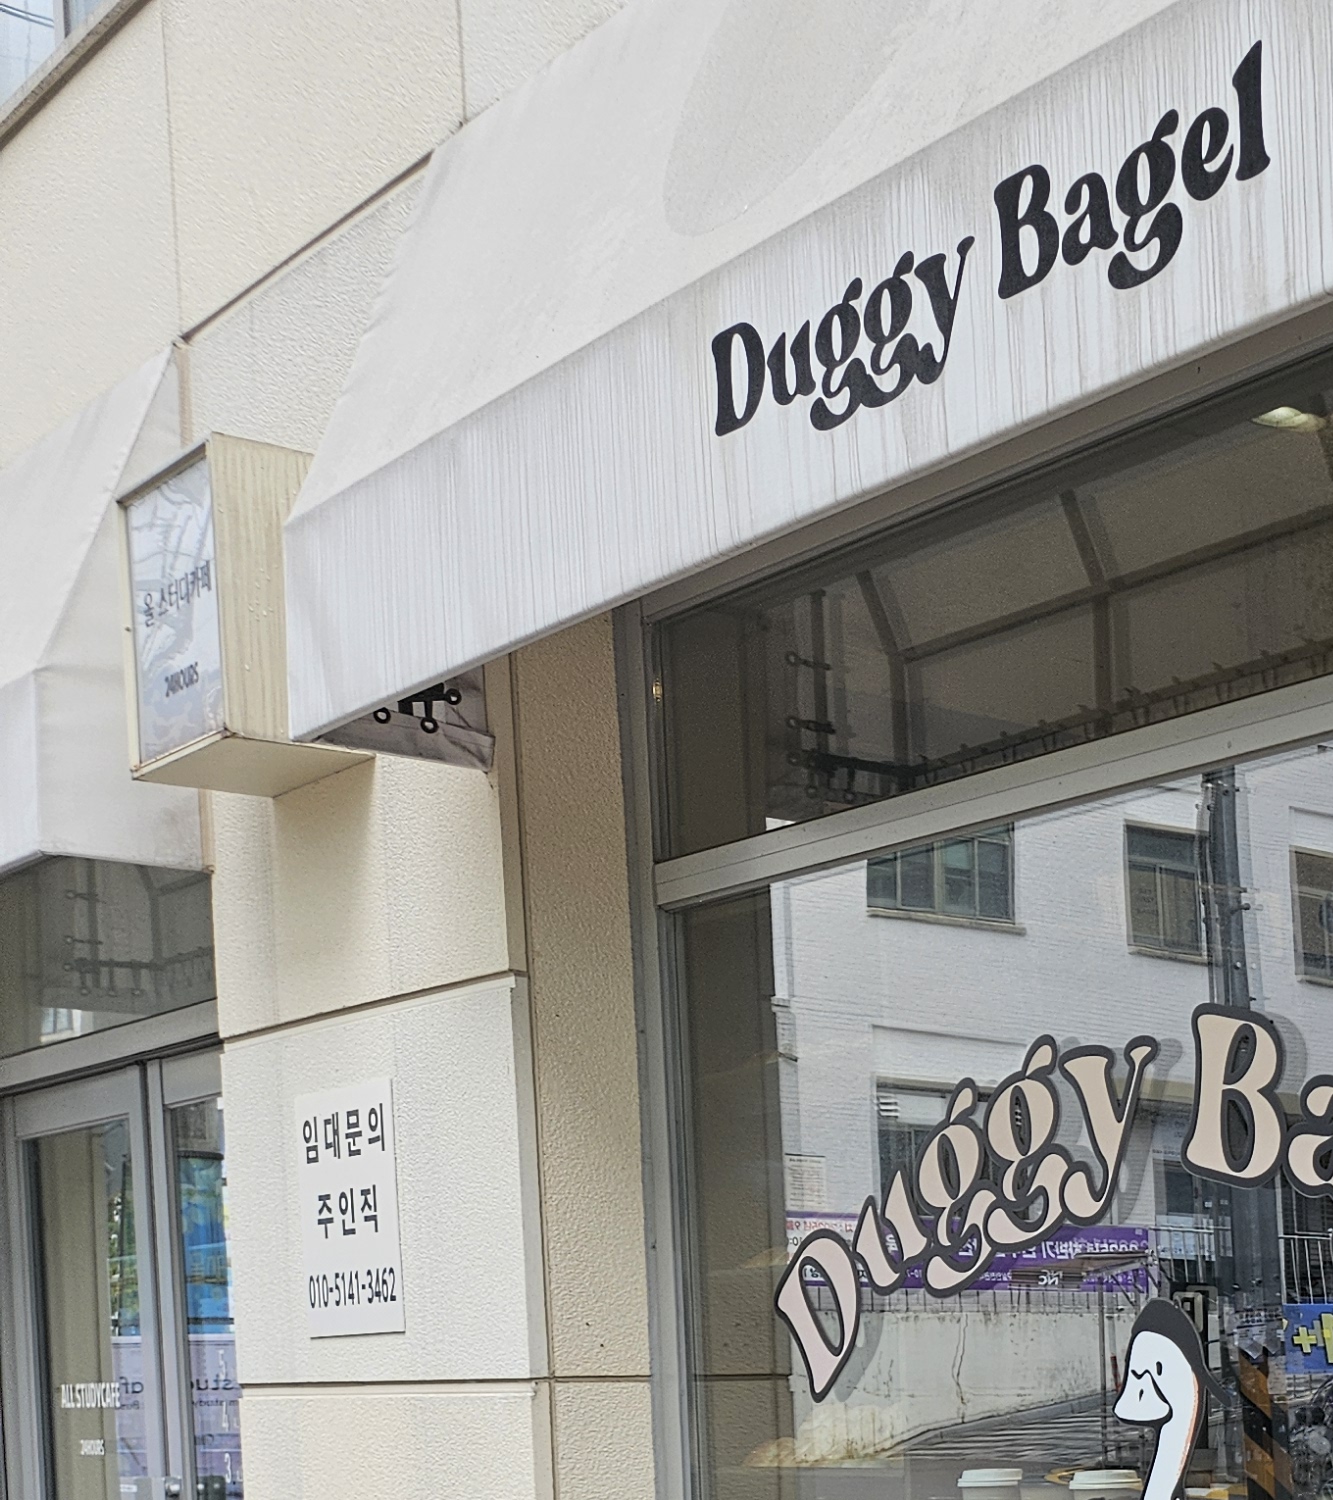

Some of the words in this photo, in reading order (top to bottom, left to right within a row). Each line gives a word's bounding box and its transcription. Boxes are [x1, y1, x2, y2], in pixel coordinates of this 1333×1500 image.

[711, 235, 975, 436] Duggy
[994, 40, 1271, 299] Bagel
[302, 1103, 386, 1164] 임대문의
[317, 1185, 378, 1238] 주인직
[775, 1034, 1157, 1402] Duggy
[309, 1267, 396, 1309] 010-5141-3462
